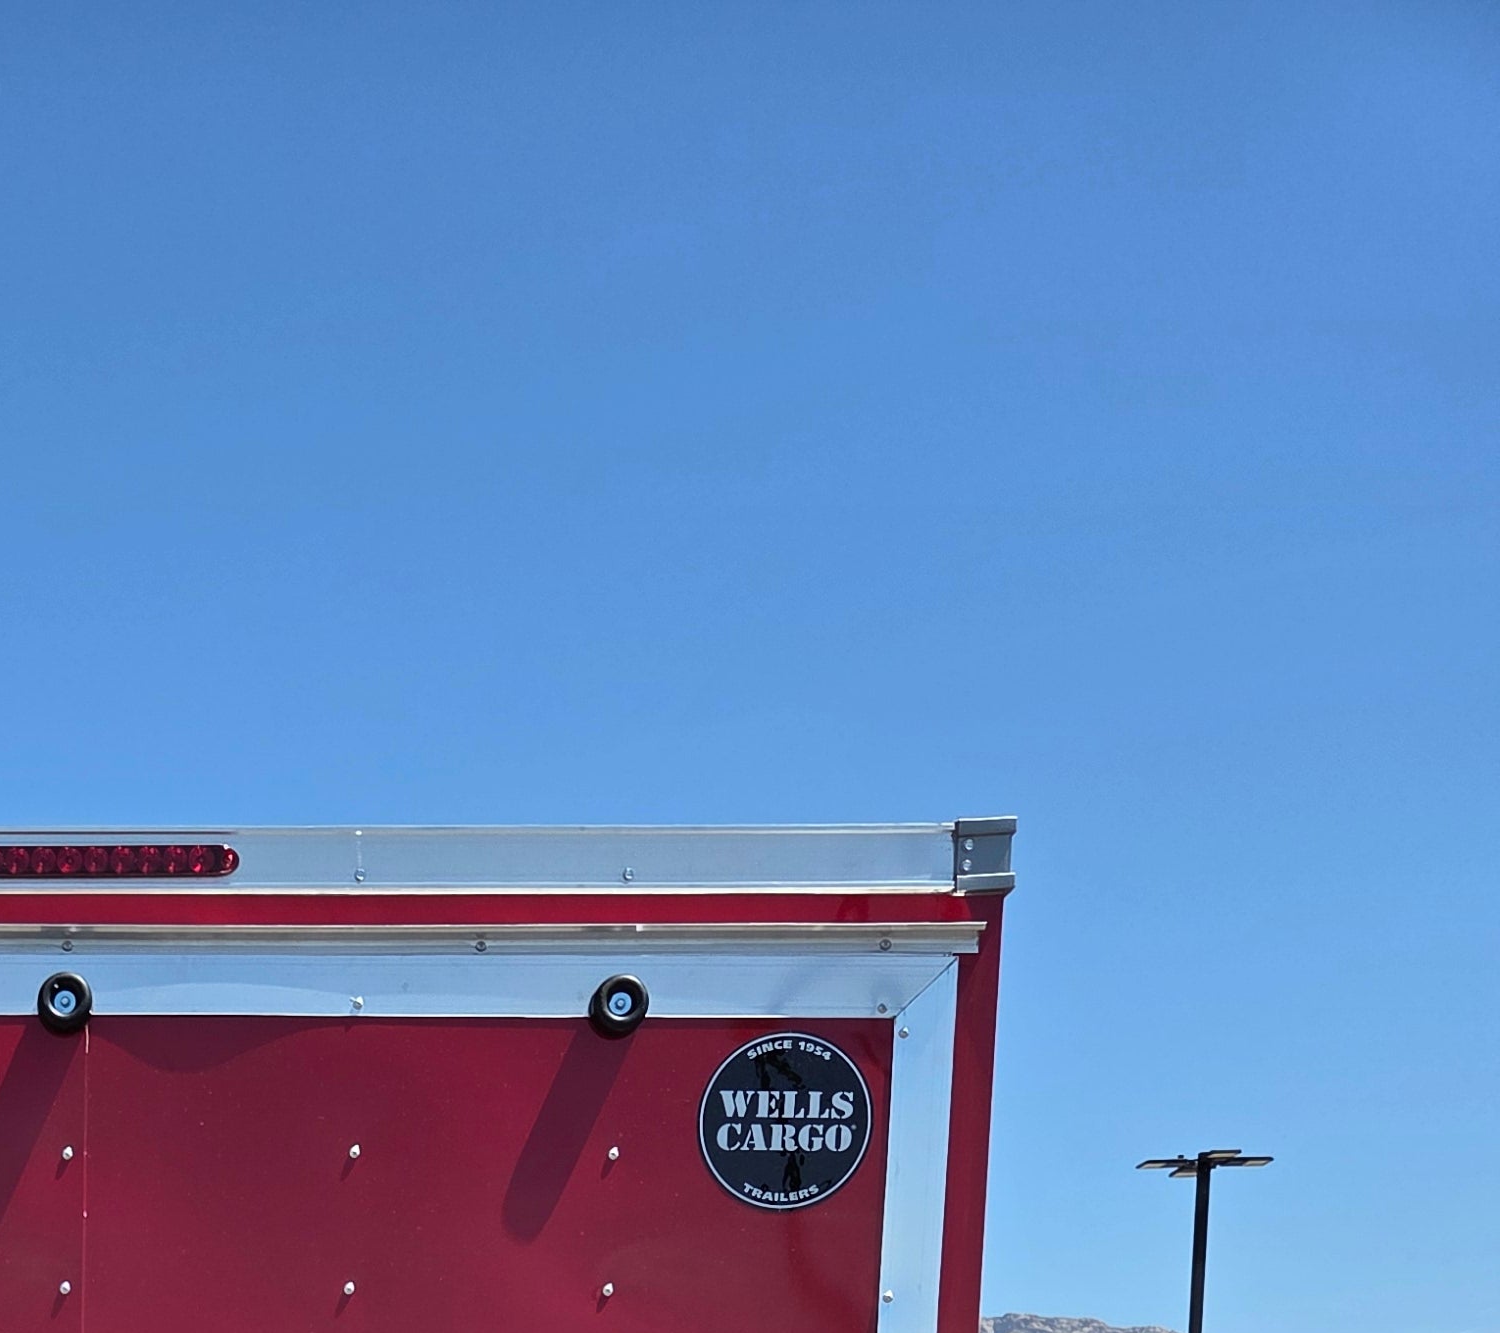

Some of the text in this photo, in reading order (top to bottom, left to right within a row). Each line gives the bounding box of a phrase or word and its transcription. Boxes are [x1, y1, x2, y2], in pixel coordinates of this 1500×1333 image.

[747, 1040, 832, 1061] SINCE 1954
[719, 1090, 854, 1120] WELLS
[716, 1123, 853, 1152] CARGO
[743, 1182, 820, 1202] TRAILERS
